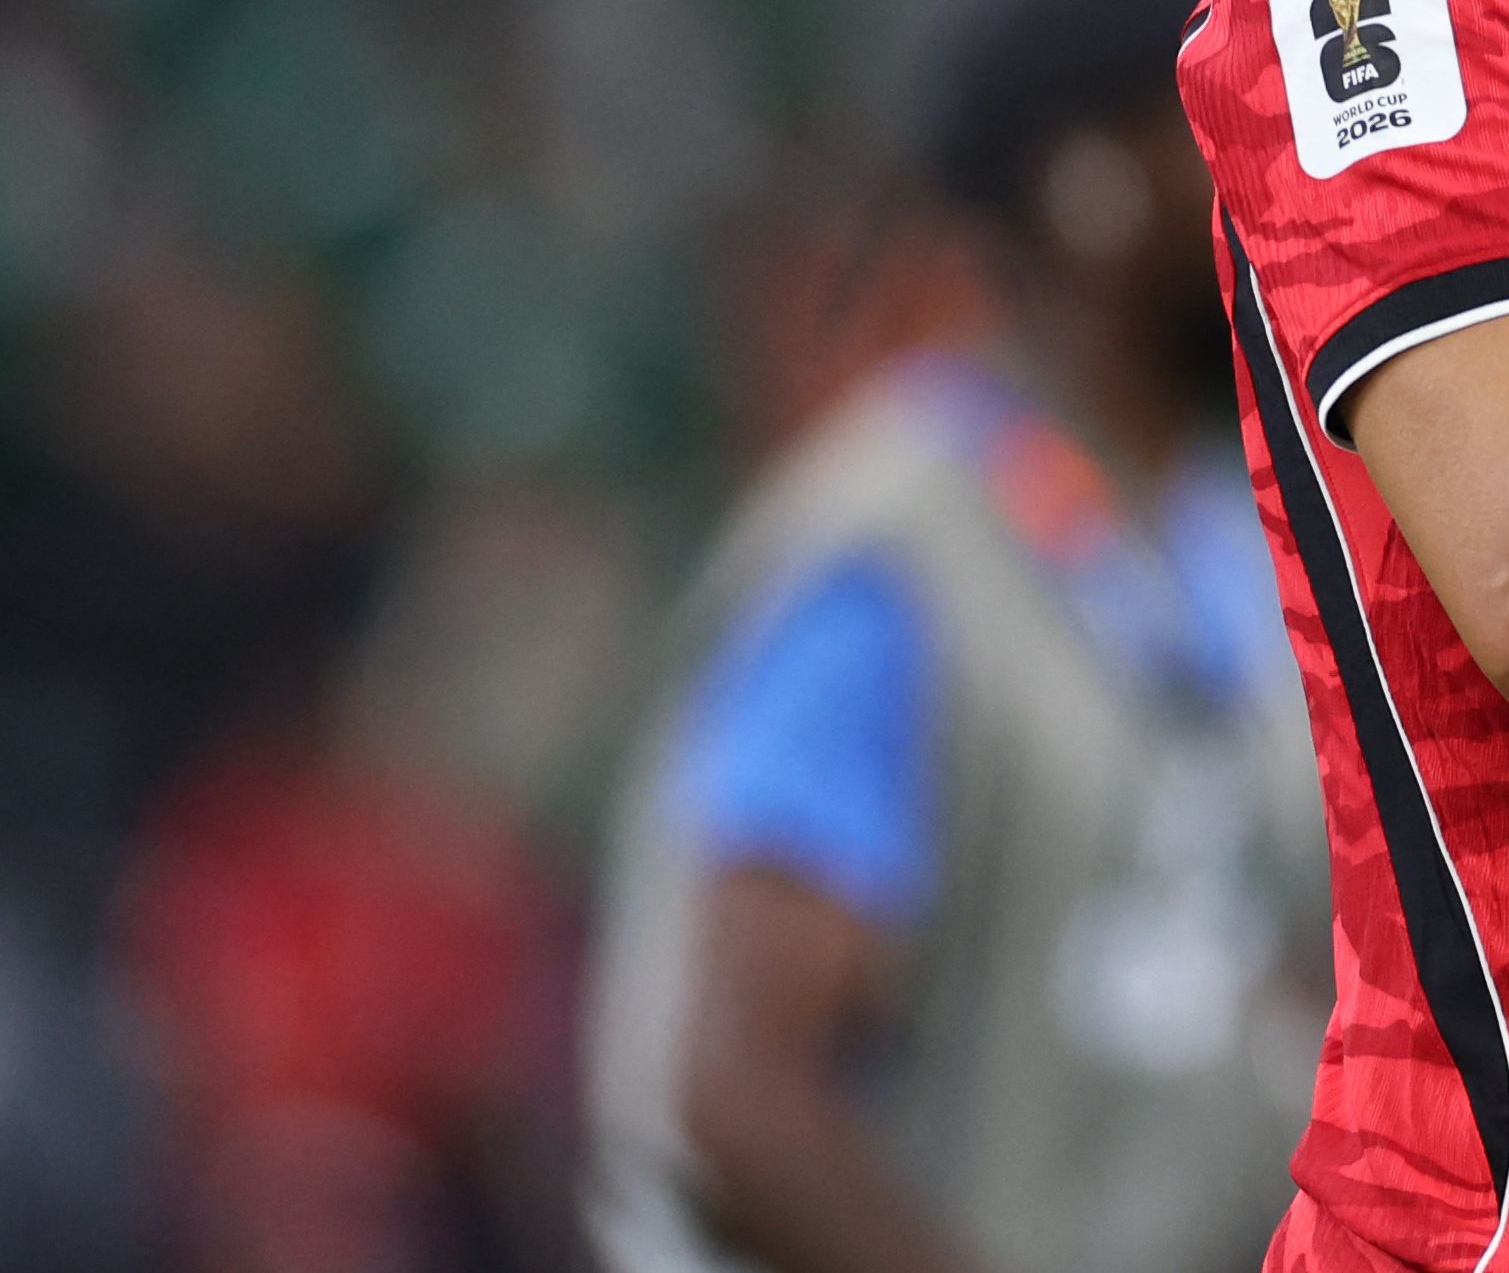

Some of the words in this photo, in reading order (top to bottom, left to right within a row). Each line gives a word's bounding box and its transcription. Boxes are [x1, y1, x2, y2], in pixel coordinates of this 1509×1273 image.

[1342, 63, 1379, 90] FIFA
[1333, 100, 1374, 126] WORLD
[1377, 93, 1408, 107] CUP
[1337, 109, 1412, 149] 2026
